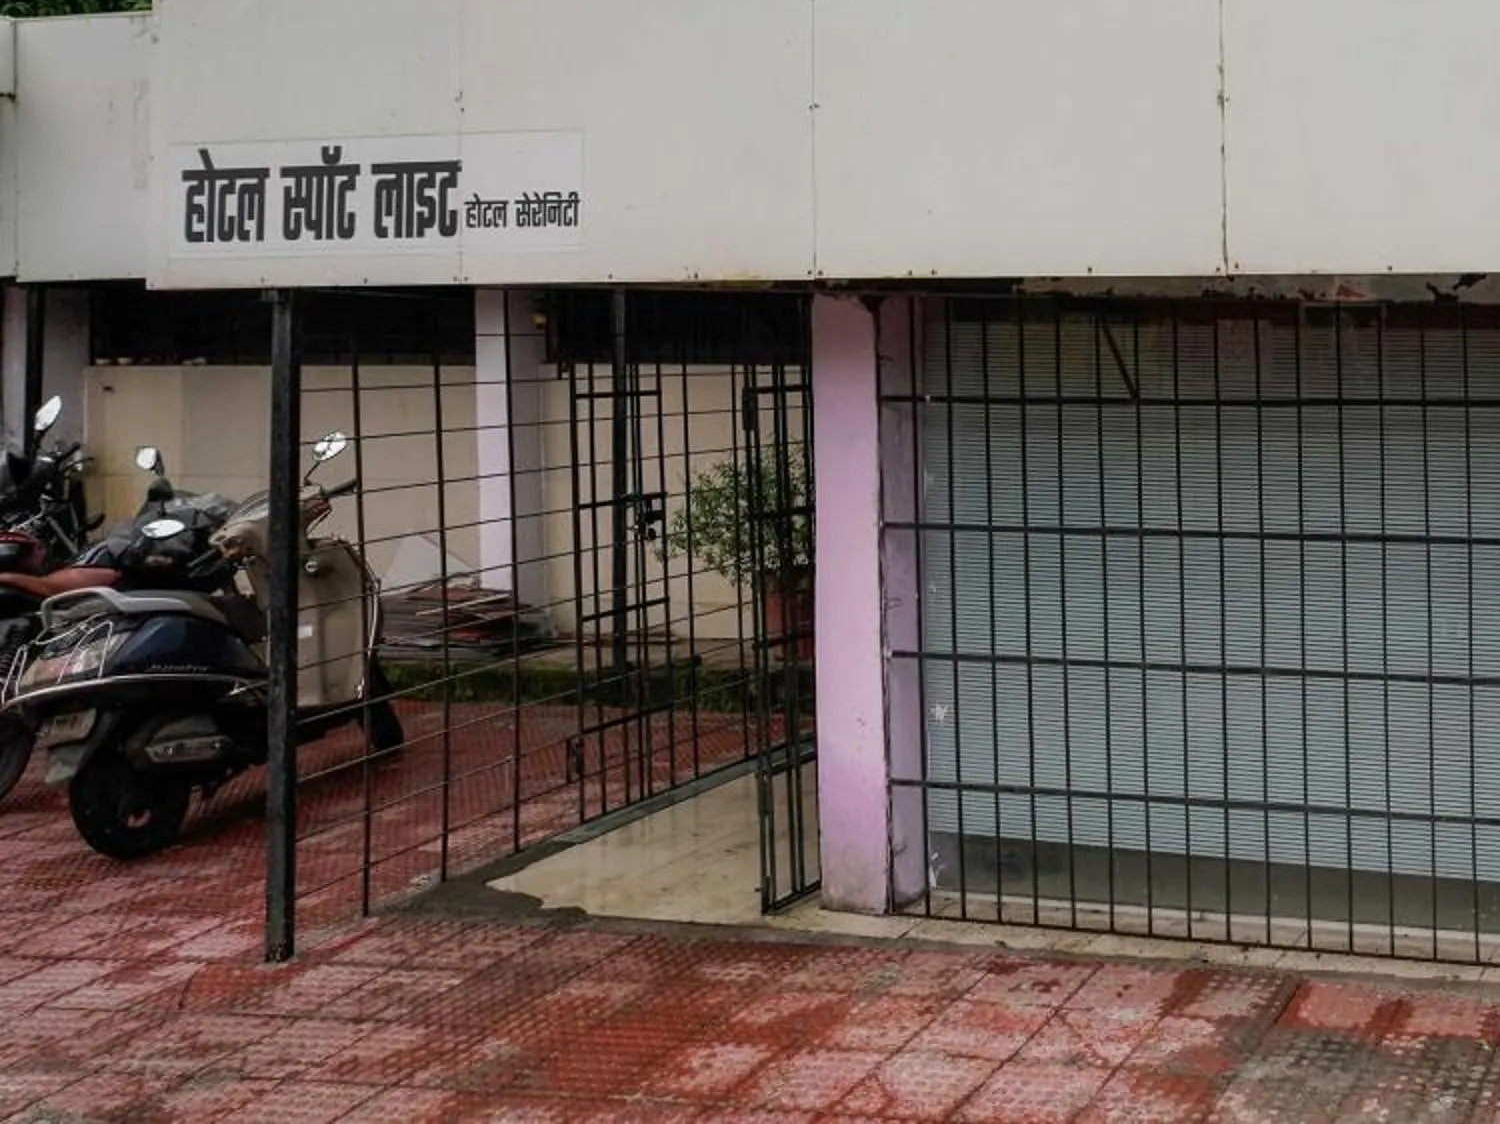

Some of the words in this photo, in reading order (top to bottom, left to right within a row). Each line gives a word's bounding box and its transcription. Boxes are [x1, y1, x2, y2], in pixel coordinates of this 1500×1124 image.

[181, 148, 271, 243] होटल
[279, 145, 361, 241] स्पॉट
[370, 159, 463, 239] लाइट
[464, 192, 508, 229] होटल
[514, 191, 581, 228] सेरेनिटी
